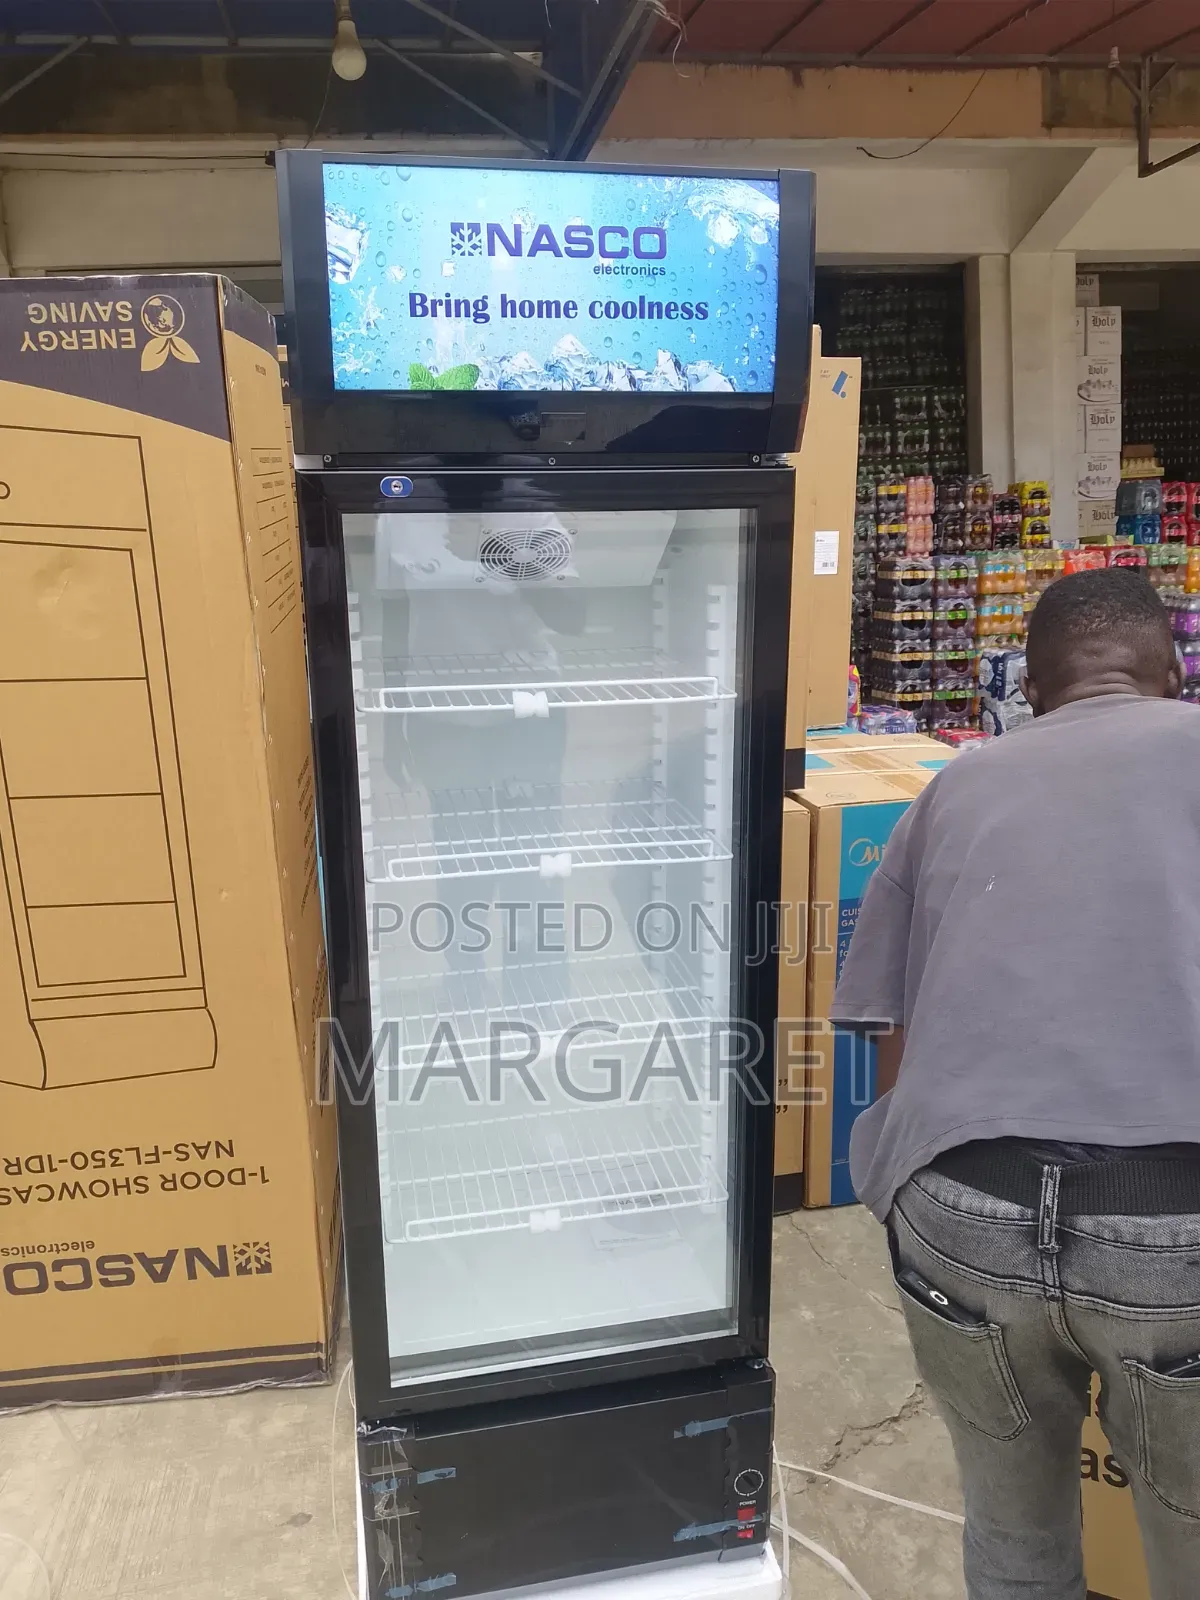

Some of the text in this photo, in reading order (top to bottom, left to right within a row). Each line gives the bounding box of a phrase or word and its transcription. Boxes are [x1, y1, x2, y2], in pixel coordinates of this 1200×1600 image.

[487, 223, 667, 259] NASCO
[593, 264, 667, 276] electronics
[28, 300, 133, 324] SAVING
[408, 292, 709, 323] Bring home coolness
[21, 328, 136, 352] ENERGY
[2, 1139, 235, 1176] NAS-FL350-1DR
[159, 1166, 270, 1192] 1-DOOR
[0, 1240, 95, 1258] electronics
[2, 1245, 230, 1296] NASCO
